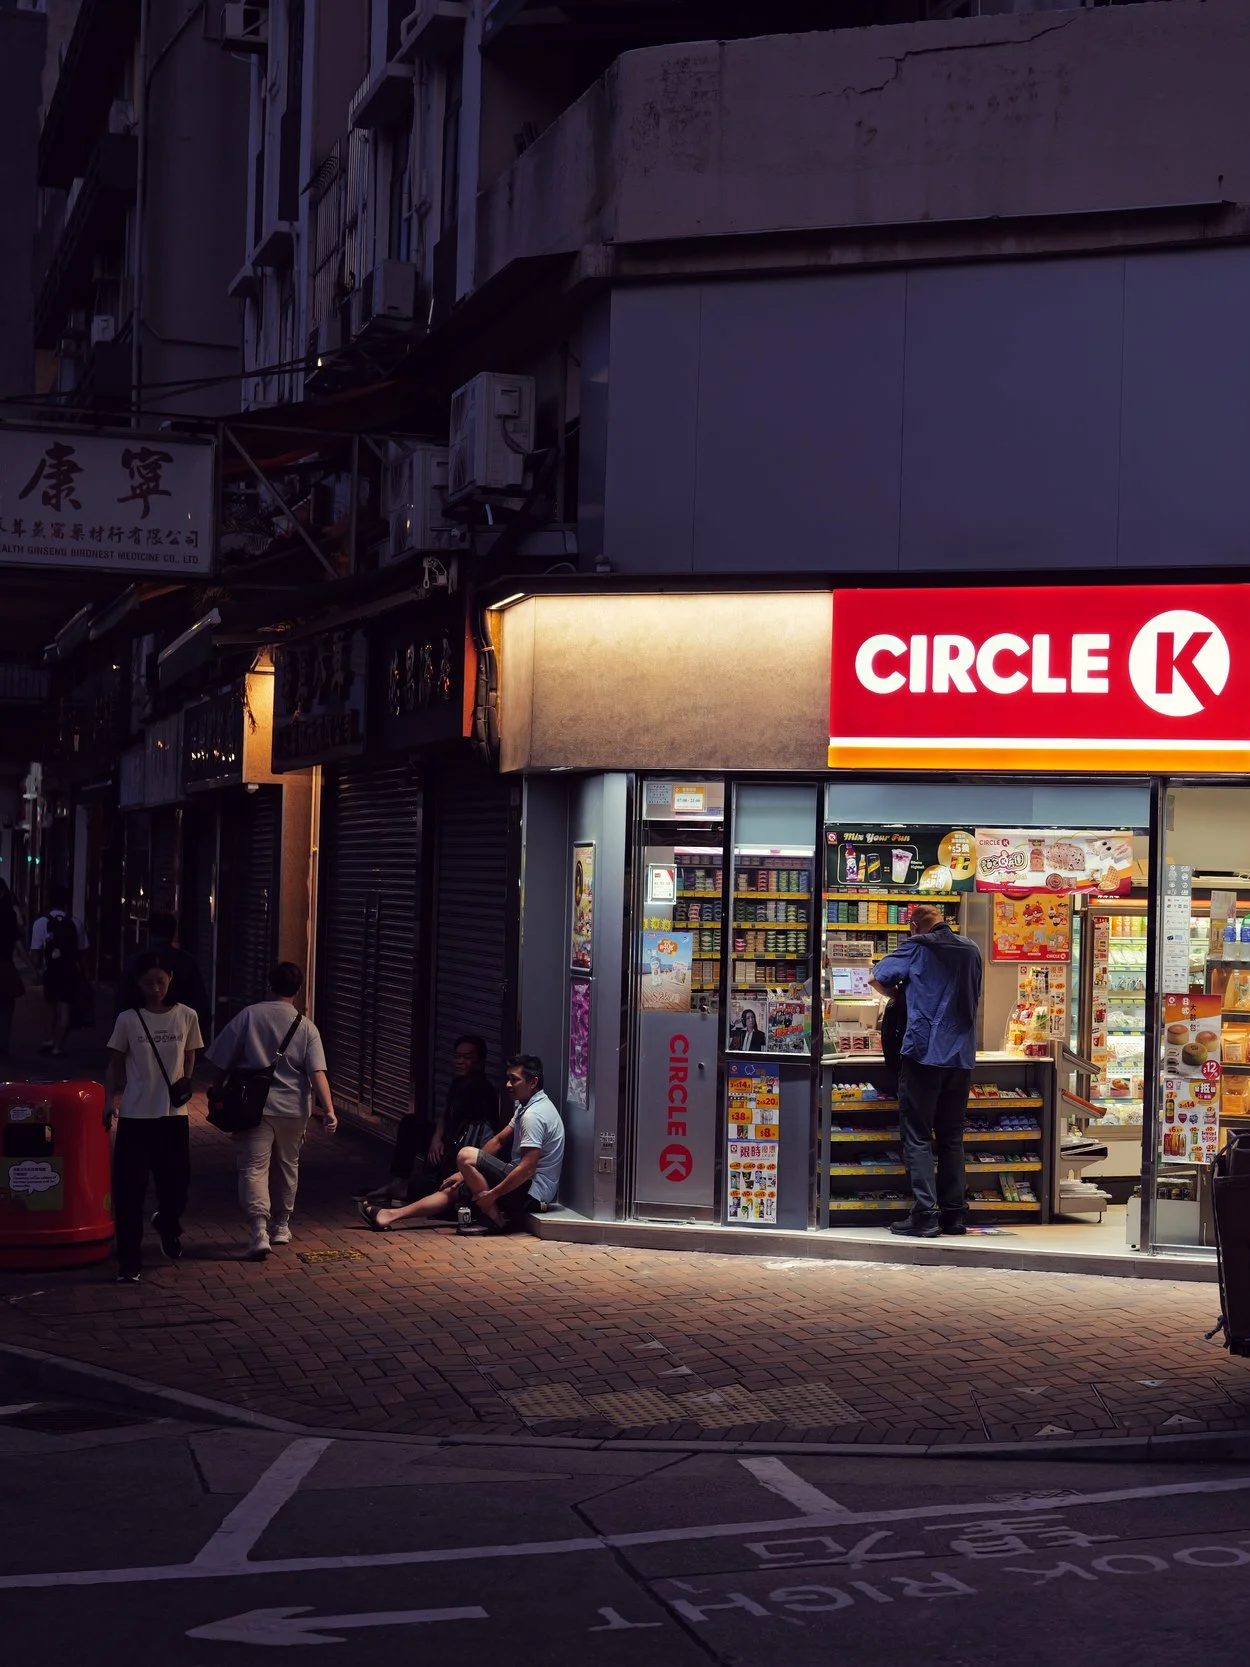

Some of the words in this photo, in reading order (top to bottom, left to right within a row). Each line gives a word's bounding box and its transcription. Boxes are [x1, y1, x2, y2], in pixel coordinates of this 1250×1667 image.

[18, 440, 174, 520] 康寧
[0, 544, 24, 554] ALTH
[27, 546, 67, 556] GINSENG
[70, 548, 114, 559] BIRDNEST
[117, 551, 160, 562] MEDICINE
[855, 633, 1110, 694] CIRCLE
[1150, 626, 1226, 712] K
[843, 832, 863, 841] Mix
[866, 833, 889, 843] Your
[891, 833, 910, 841] Fun
[1002, 839, 1010, 847] K
[667, 1034, 690, 1137] CIRCLE
[661, 1149, 690, 1180] K
[745, 1514, 1121, 1569] 望右
[587, 1571, 978, 1633] RIGHT
